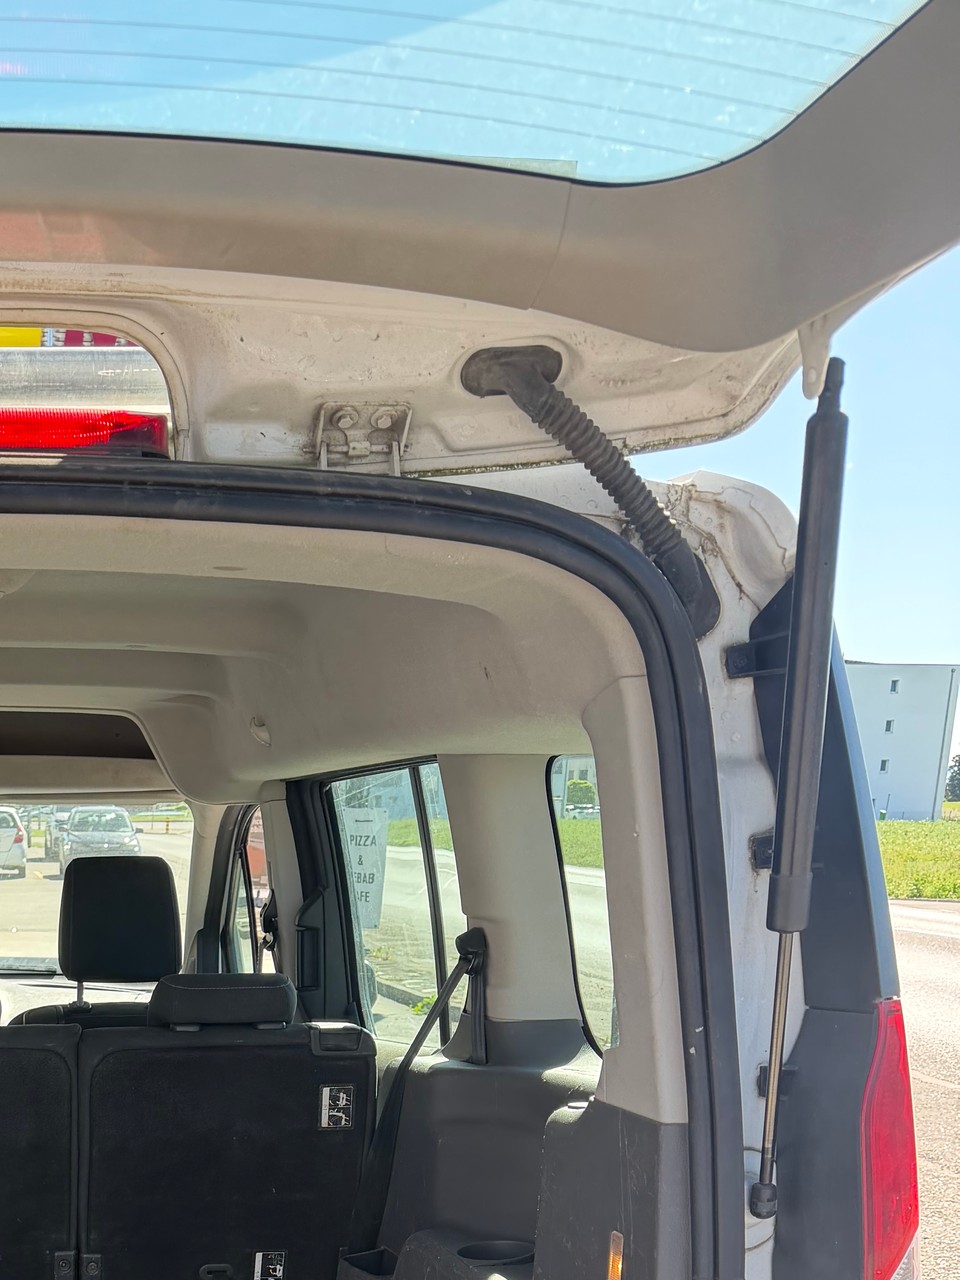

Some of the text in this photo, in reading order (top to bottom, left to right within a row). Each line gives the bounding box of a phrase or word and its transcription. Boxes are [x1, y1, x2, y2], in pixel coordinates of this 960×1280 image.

[349, 834, 377, 847] PIZZA
[357, 854, 364, 866] &
[353, 872, 375, 884] EBAB
